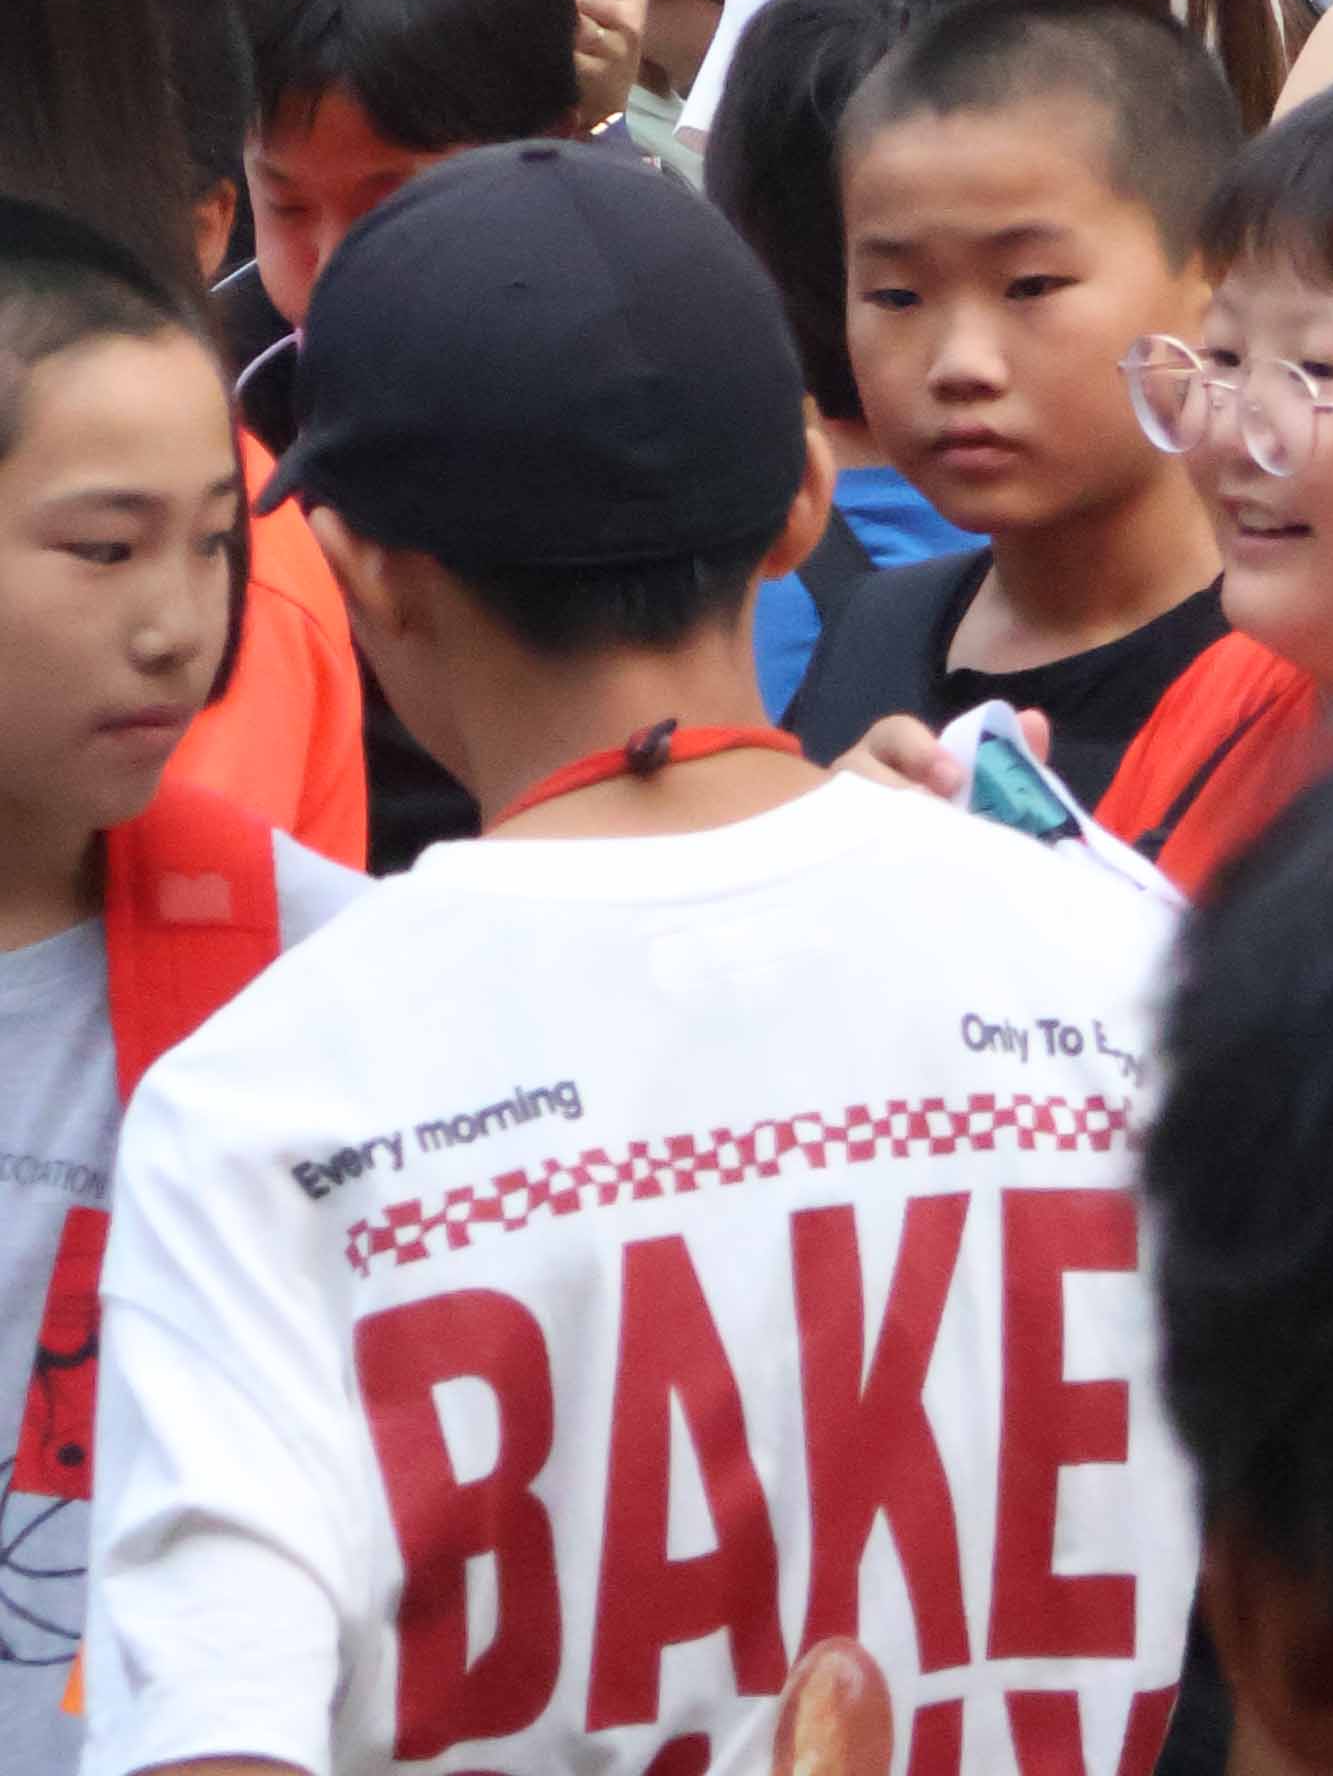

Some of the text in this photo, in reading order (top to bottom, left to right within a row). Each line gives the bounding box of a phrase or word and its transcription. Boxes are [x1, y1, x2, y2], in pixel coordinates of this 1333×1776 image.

[961, 1011, 1030, 1064] Only
[1034, 1017, 1085, 1057] To
[290, 1078, 584, 1200] Every morning
[352, 1186, 1142, 1763] BAKE
